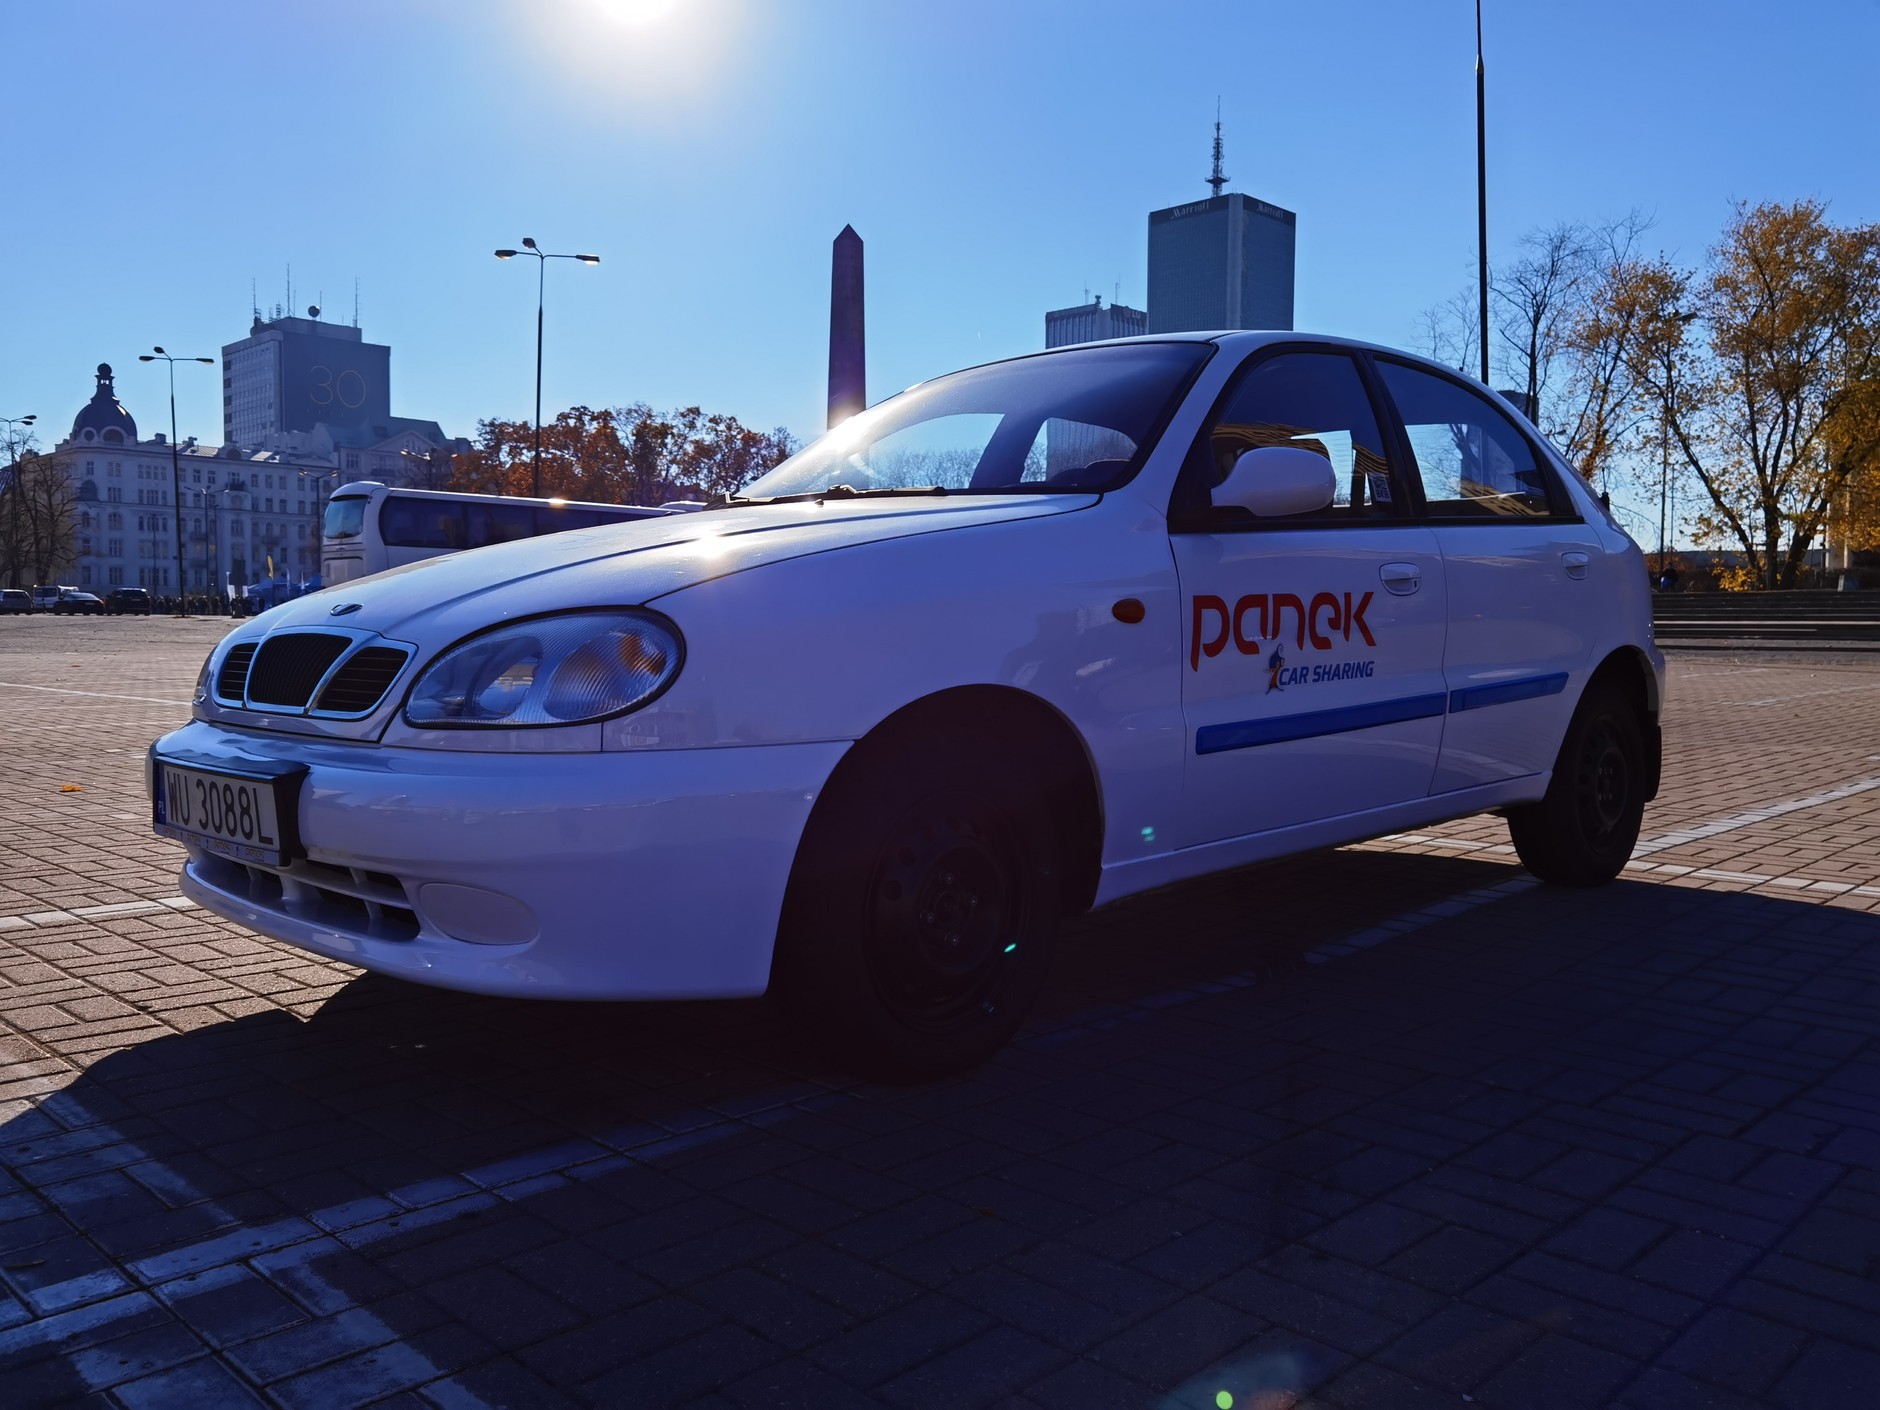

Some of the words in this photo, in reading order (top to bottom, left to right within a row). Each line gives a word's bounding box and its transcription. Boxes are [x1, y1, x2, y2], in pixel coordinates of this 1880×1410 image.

[309, 365, 366, 408] 30
[1278, 665, 1309, 686] CAR
[1311, 660, 1375, 684] SHARING
[157, 800, 166, 815] PL
[166, 770, 191, 826] WU
[195, 777, 274, 846] 3088L
